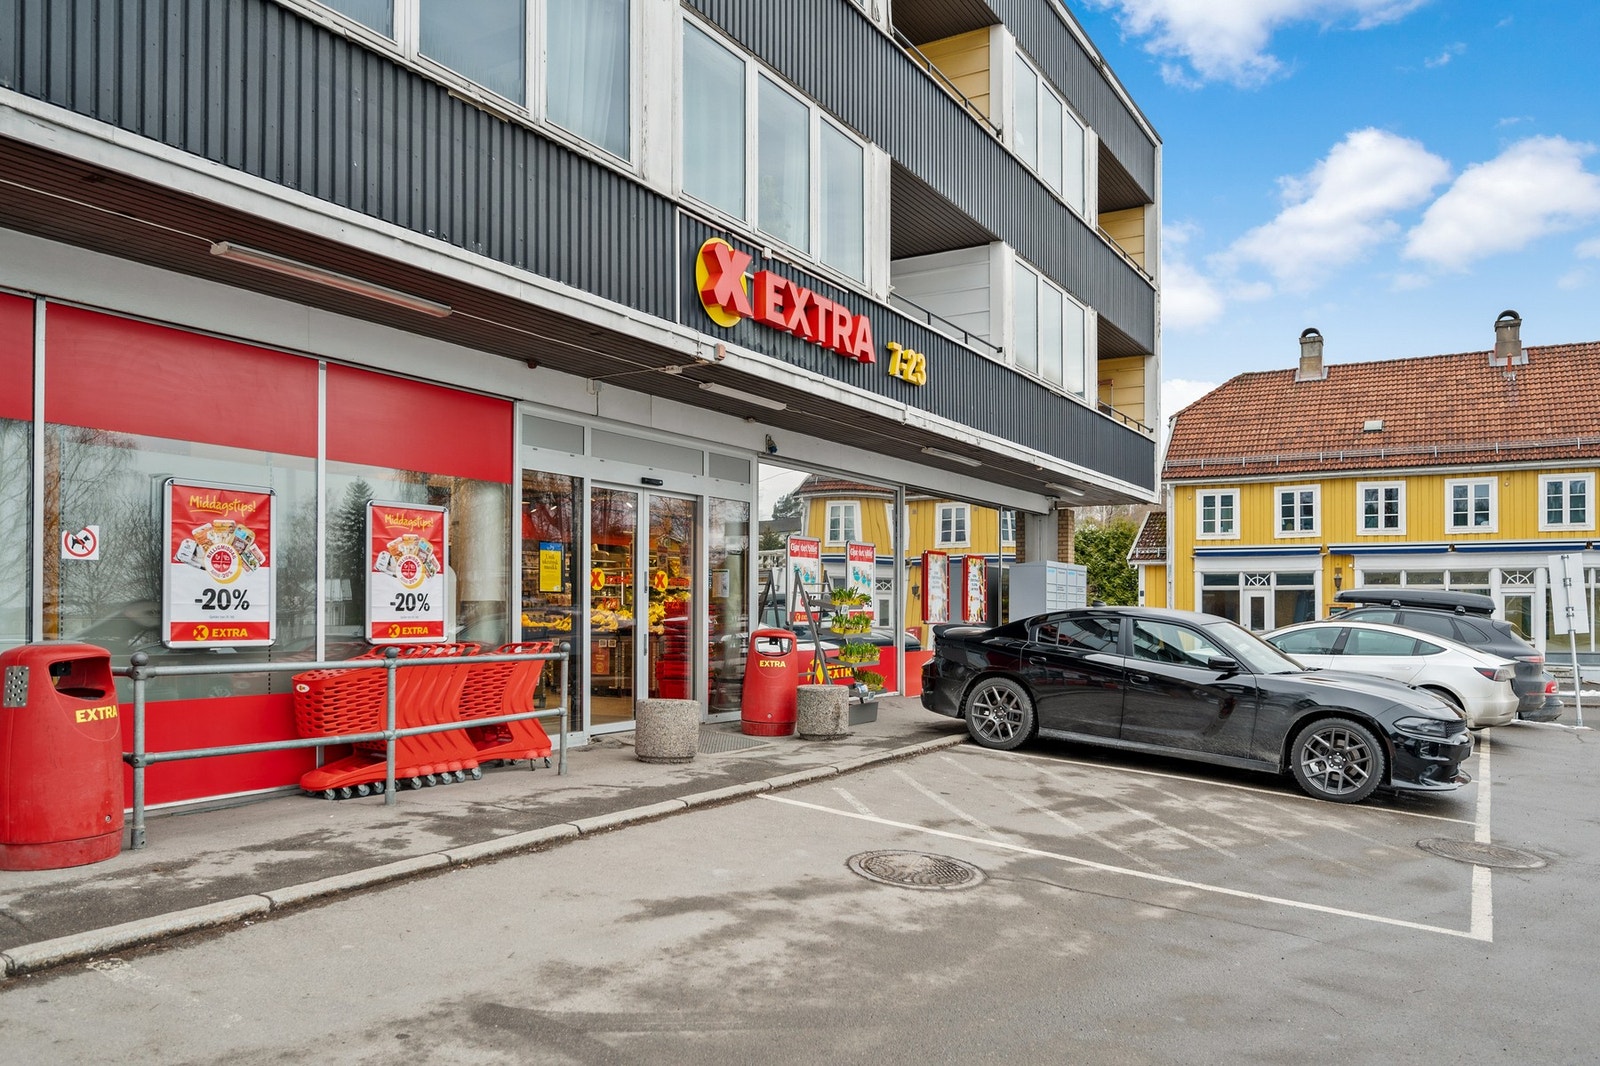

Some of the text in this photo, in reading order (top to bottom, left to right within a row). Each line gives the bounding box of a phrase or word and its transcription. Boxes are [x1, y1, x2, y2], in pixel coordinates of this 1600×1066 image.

[754, 270, 876, 364] EXTRA
[189, 495, 256, 517] Middagstips!
[384, 514, 434, 532] Middagstips!
[194, 588, 250, 611] -20%
[390, 593, 430, 612] -20%
[212, 628, 248, 638] EXTRA
[402, 627, 429, 635] EXTRA
[759, 660, 786, 668] EXTRA
[826, 664, 854, 679] EXTR
[75, 705, 118, 723] EXTRA
